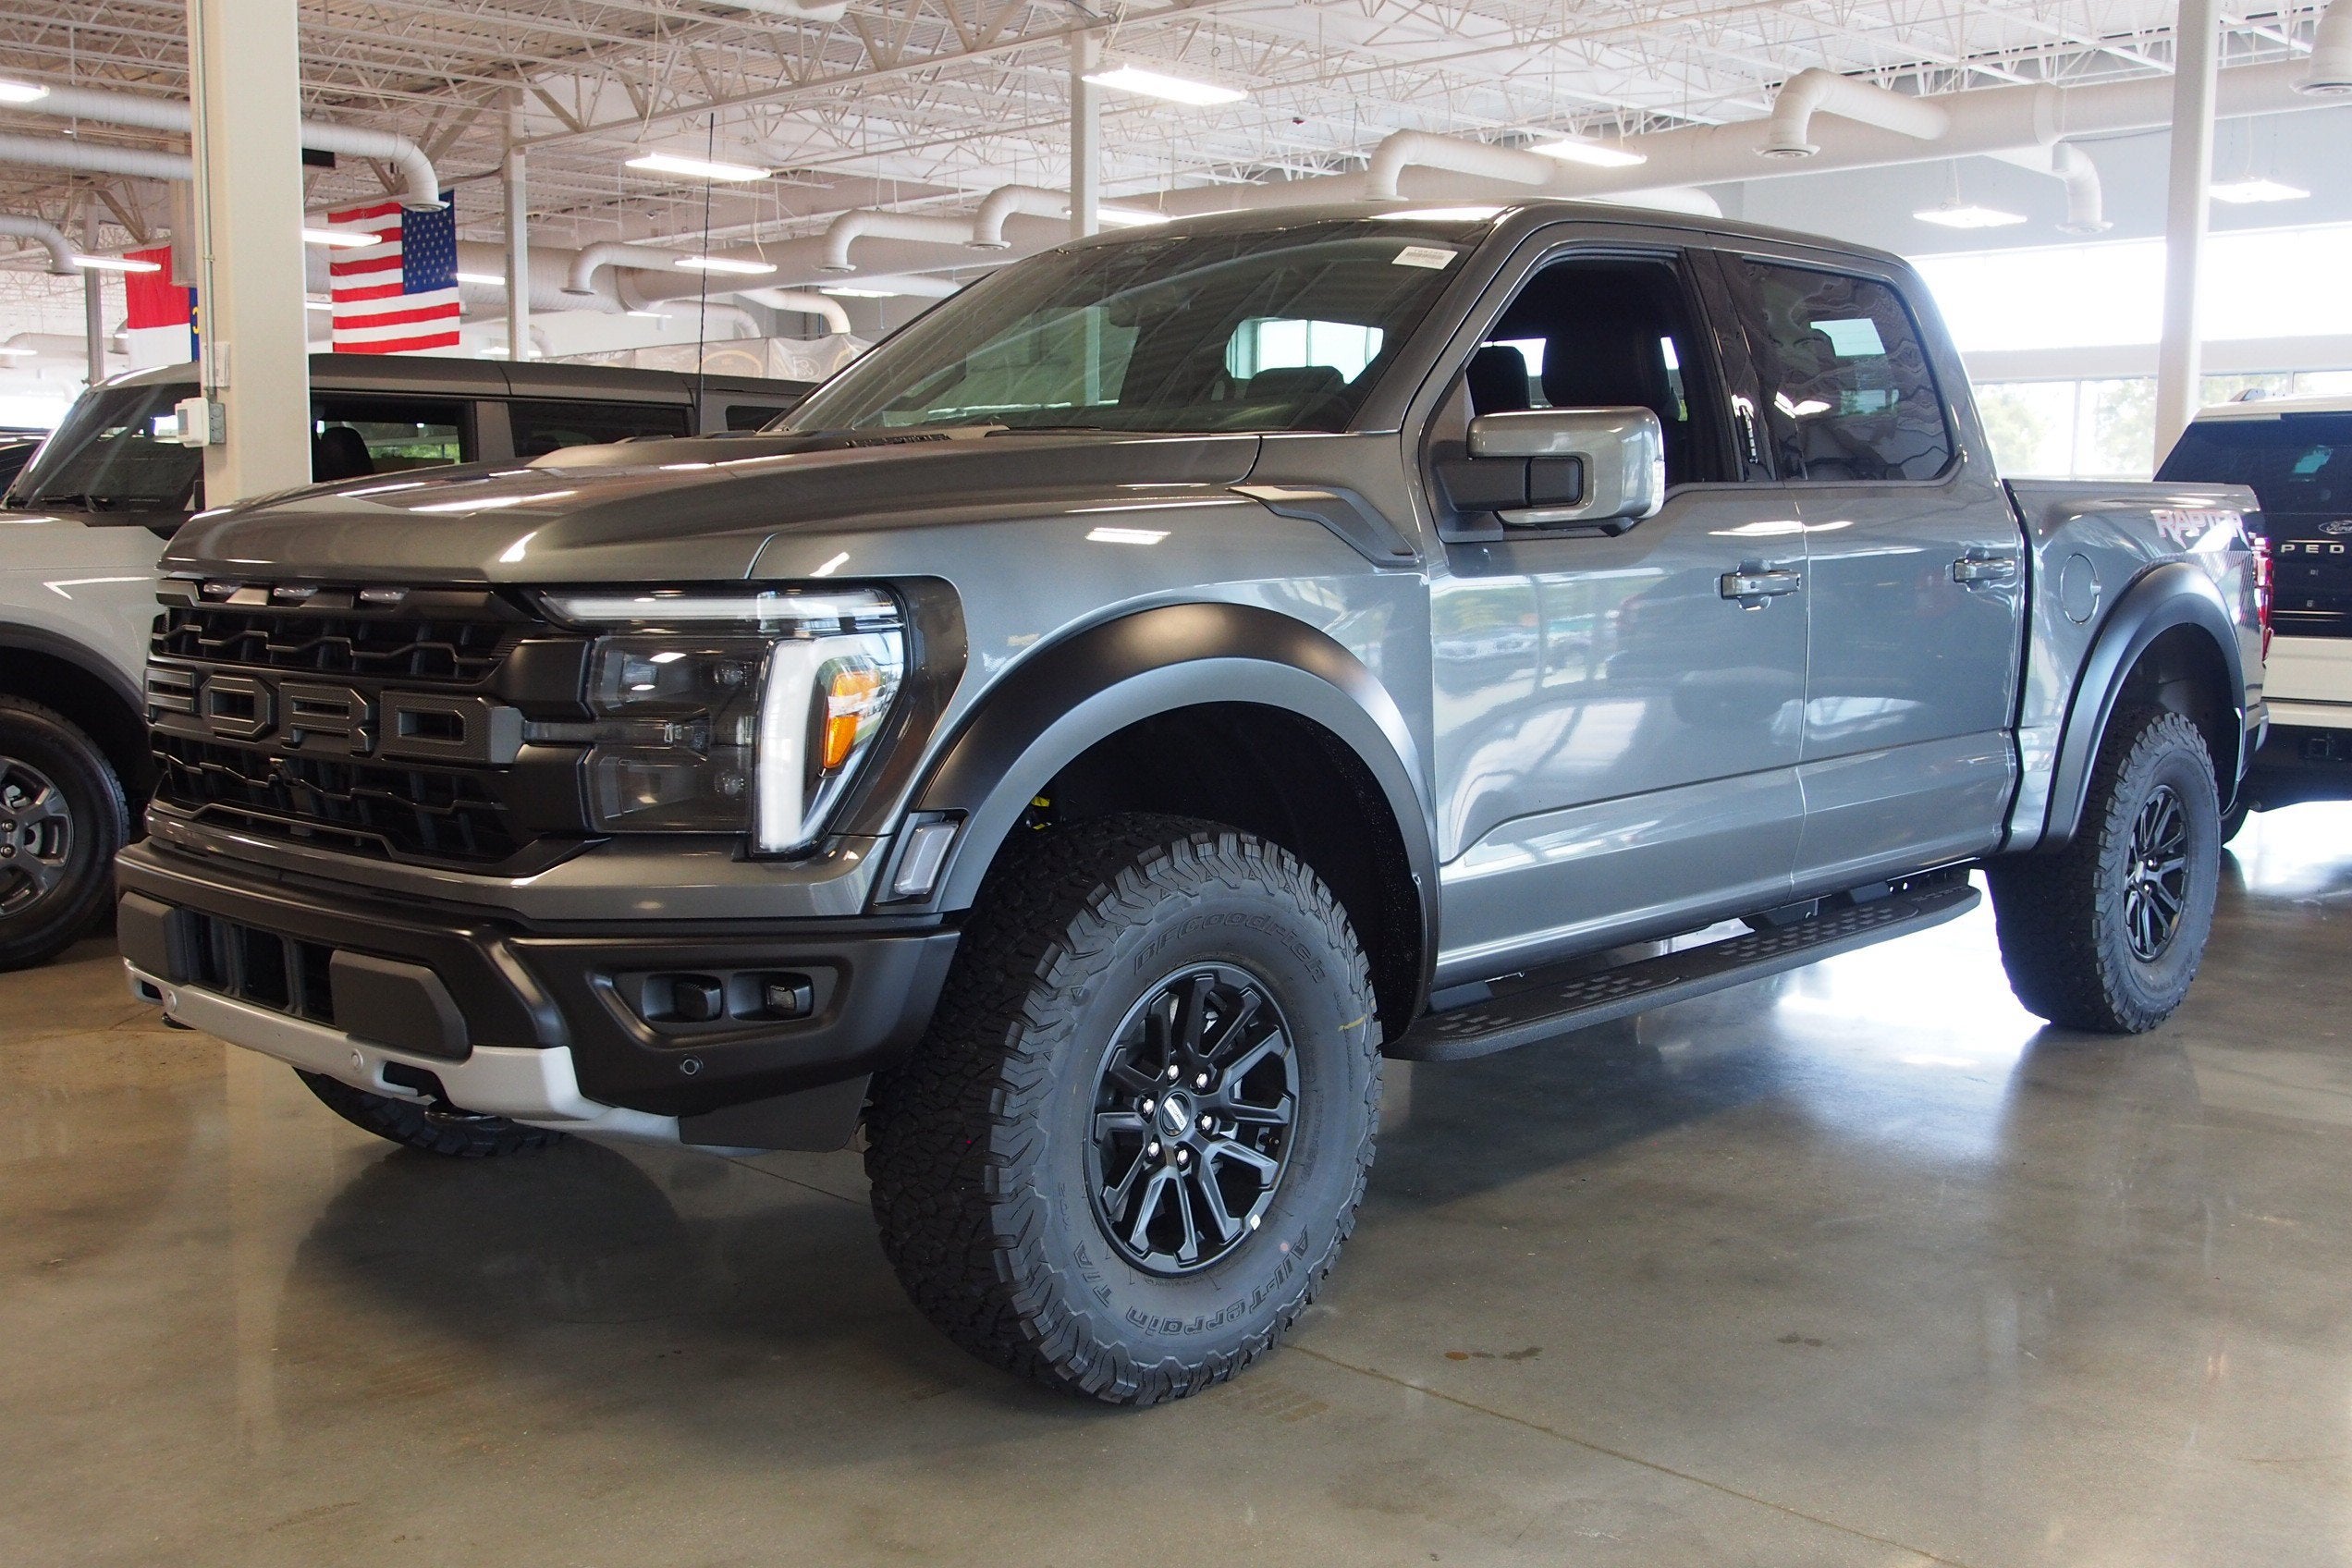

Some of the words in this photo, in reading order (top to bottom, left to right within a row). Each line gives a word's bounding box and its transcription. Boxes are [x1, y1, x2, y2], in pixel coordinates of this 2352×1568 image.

[2150, 509, 2250, 552] RAPTR
[143, 665, 520, 766] FORD
[1133, 912, 1326, 984] BFGoodrich
[1125, 1223, 1309, 1337] All-Terrain
